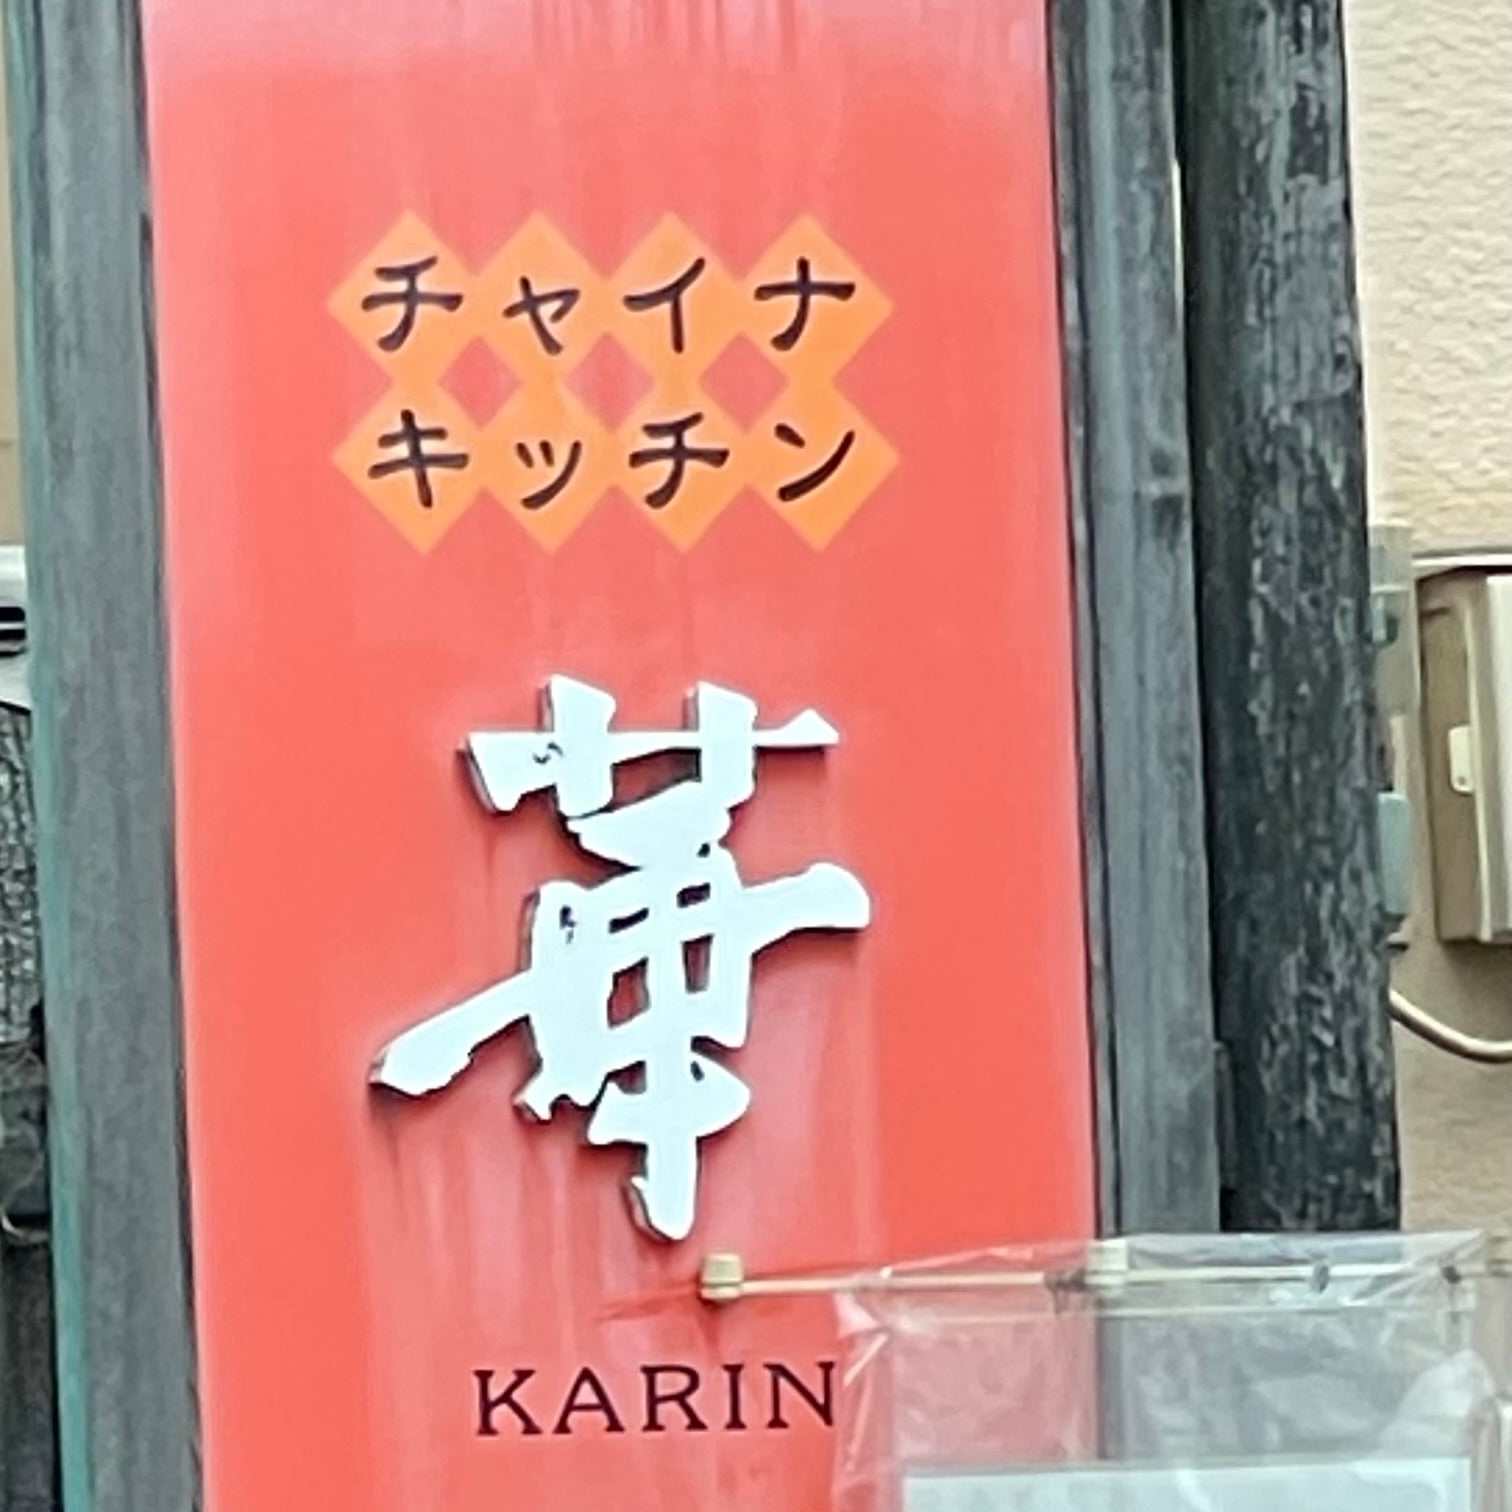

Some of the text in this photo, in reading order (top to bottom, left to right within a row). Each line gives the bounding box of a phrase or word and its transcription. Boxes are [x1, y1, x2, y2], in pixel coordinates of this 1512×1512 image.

[361, 255, 855, 356] チャイナ
[367, 408, 855, 510] キッチン
[369, 674, 870, 1240] 華
[473, 1361, 836, 1436] KARIN
